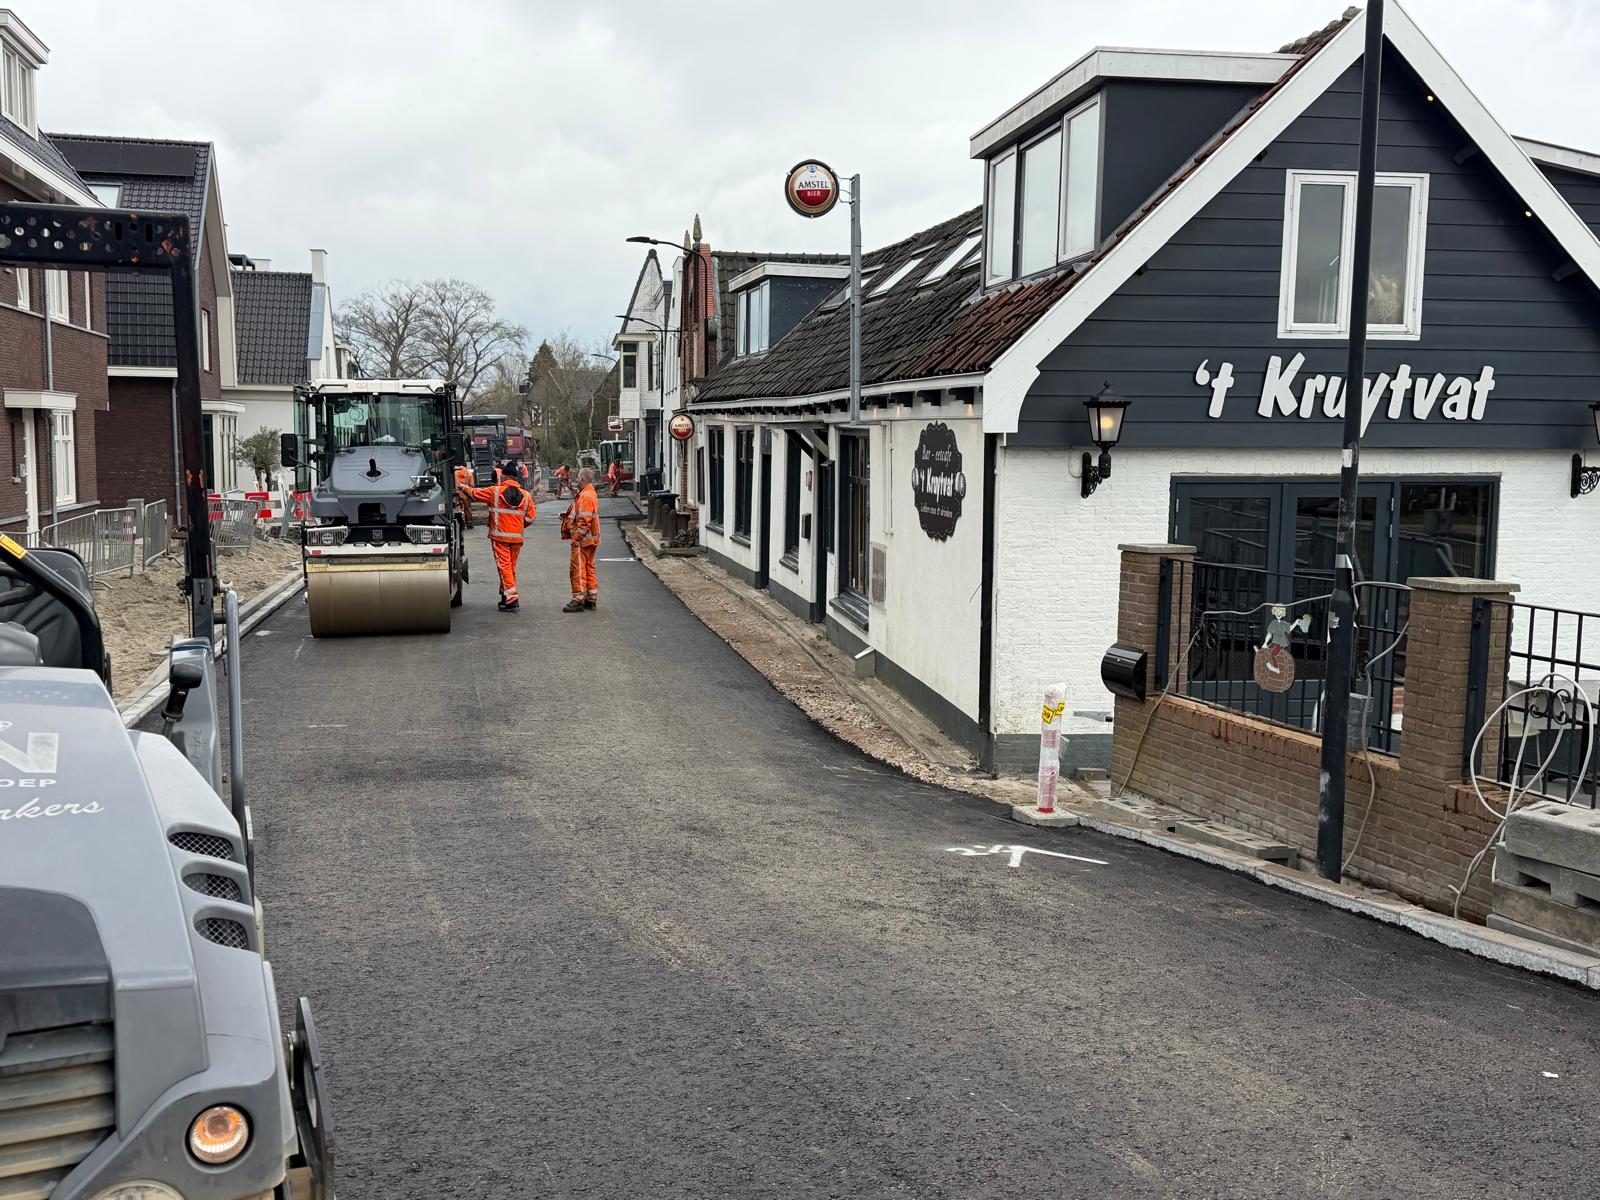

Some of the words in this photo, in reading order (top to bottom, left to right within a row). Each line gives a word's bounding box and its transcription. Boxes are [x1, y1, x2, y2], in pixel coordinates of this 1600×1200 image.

[798, 180, 829, 189] AMSTEL
[1195, 358, 1235, 419] 't
[1257, 351, 1496, 438] Kruytvat
[926, 466, 954, 504] Kruytvat
